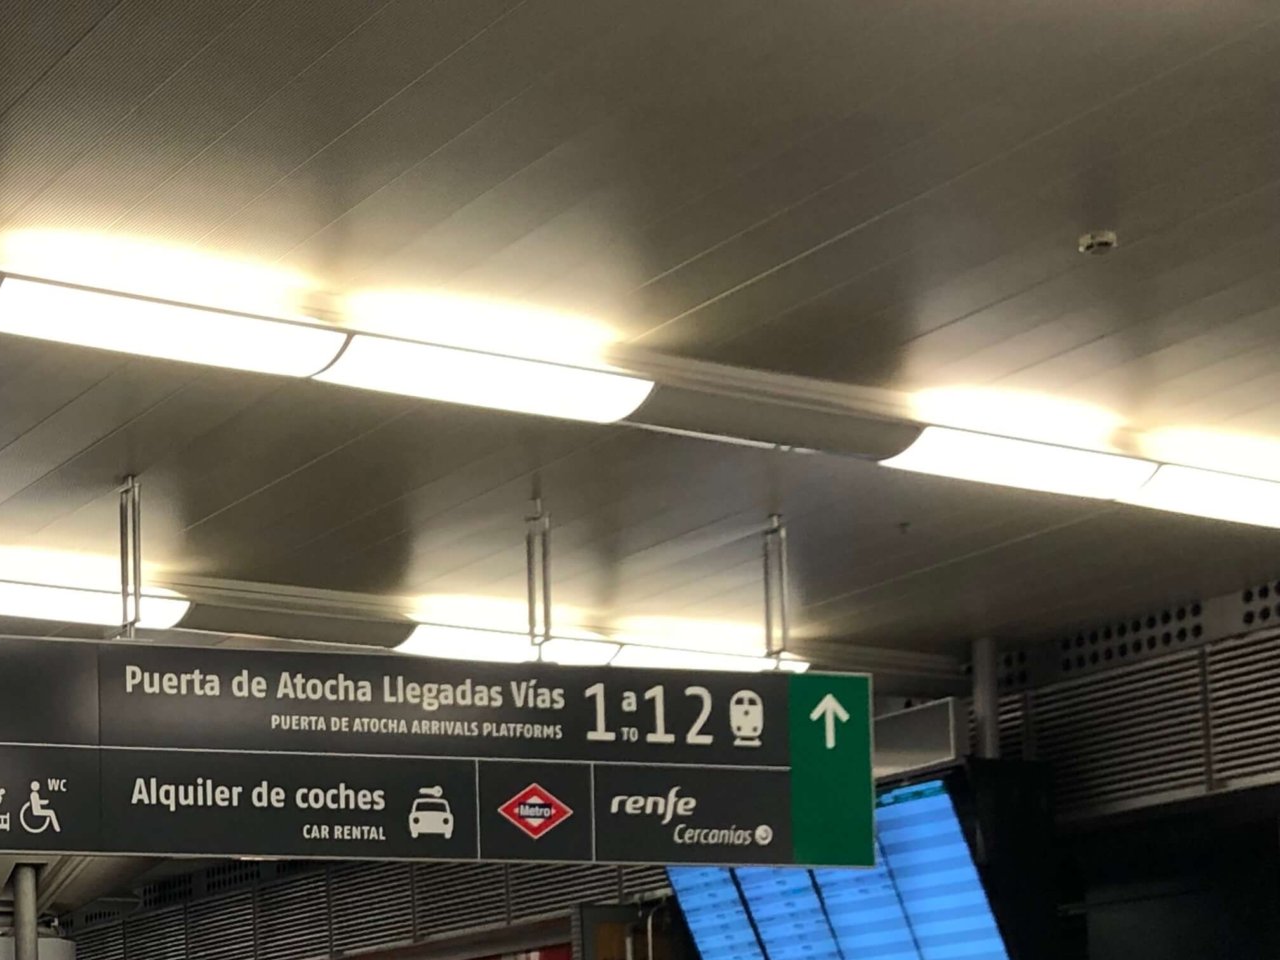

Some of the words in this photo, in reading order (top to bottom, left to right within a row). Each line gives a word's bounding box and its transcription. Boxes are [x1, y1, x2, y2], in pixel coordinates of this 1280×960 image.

[125, 665, 221, 697] Puerta
[231, 669, 267, 699] de
[276, 671, 372, 703] Atocha
[383, 675, 503, 712] Llegadas
[510, 679, 565, 710] Vías
[584, 682, 616, 741] 1
[644, 685, 714, 745] 12
[270, 714, 327, 731] PUERTA
[330, 716, 350, 732] DE
[353, 717, 408, 734] ATOCHA
[411, 719, 479, 737] ARRIVALS
[482, 721, 563, 740] PLATFORMS
[620, 726, 639, 742] TO
[47, 778, 67, 792] WC
[131, 777, 242, 811] Alquiler
[251, 780, 286, 808] de
[295, 782, 386, 811] coches
[519, 804, 552, 818] Metro
[610, 786, 697, 824] renfe
[302, 824, 330, 839] CAR
[333, 825, 386, 841] RENTAL
[673, 823, 753, 846] Cercanías
